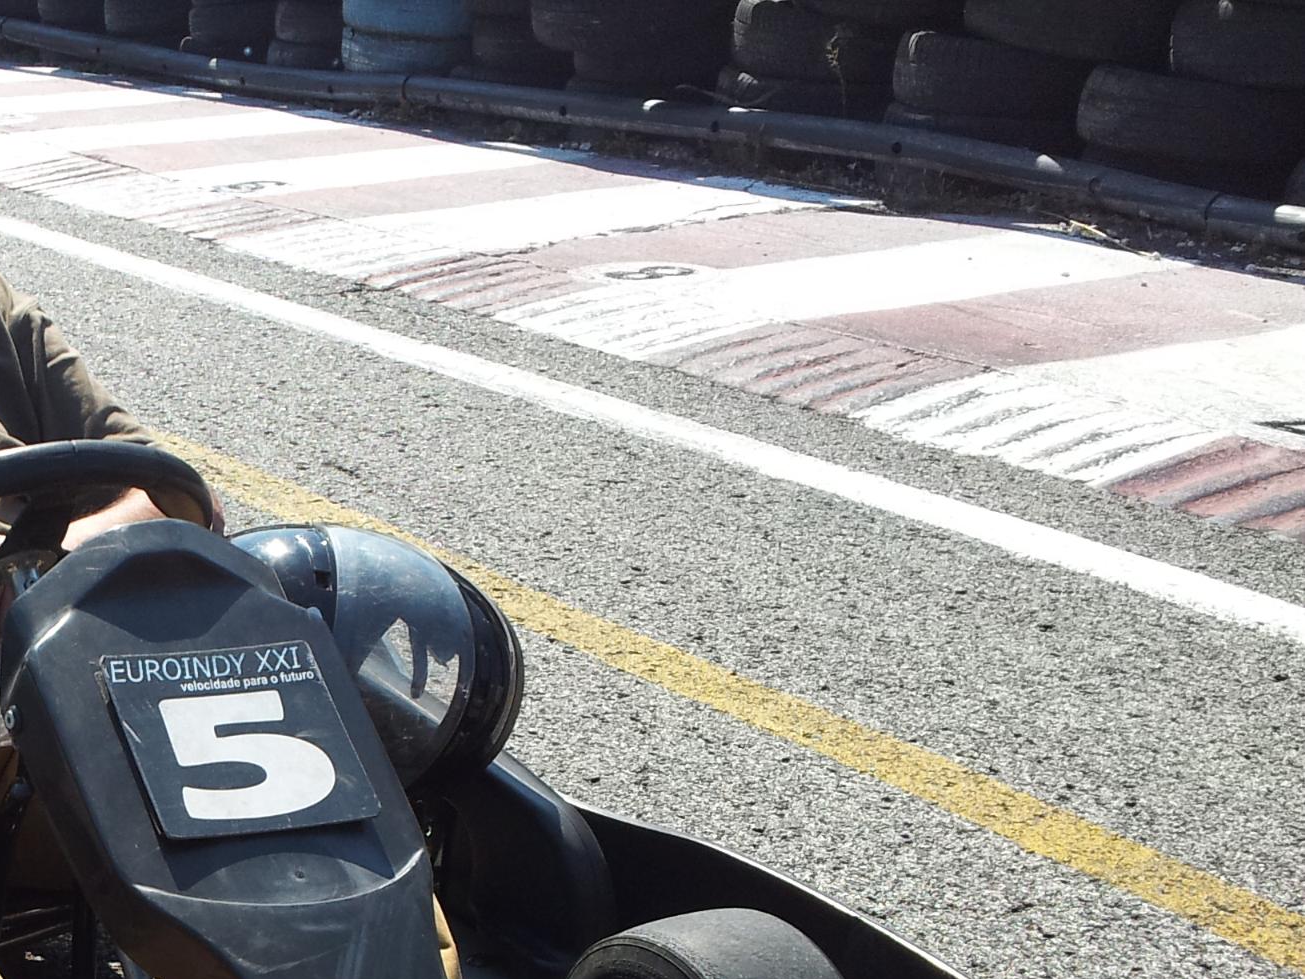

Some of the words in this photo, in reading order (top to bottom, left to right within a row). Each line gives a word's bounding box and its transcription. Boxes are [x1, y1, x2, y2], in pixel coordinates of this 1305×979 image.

[109, 652, 246, 684] EUROINDY
[255, 646, 302, 673] XXI
[180, 676, 241, 693] velocidade
[243, 673, 269, 689] para
[270, 674, 279, 684] o
[279, 669, 315, 684] futuro
[158, 689, 336, 820] 5
